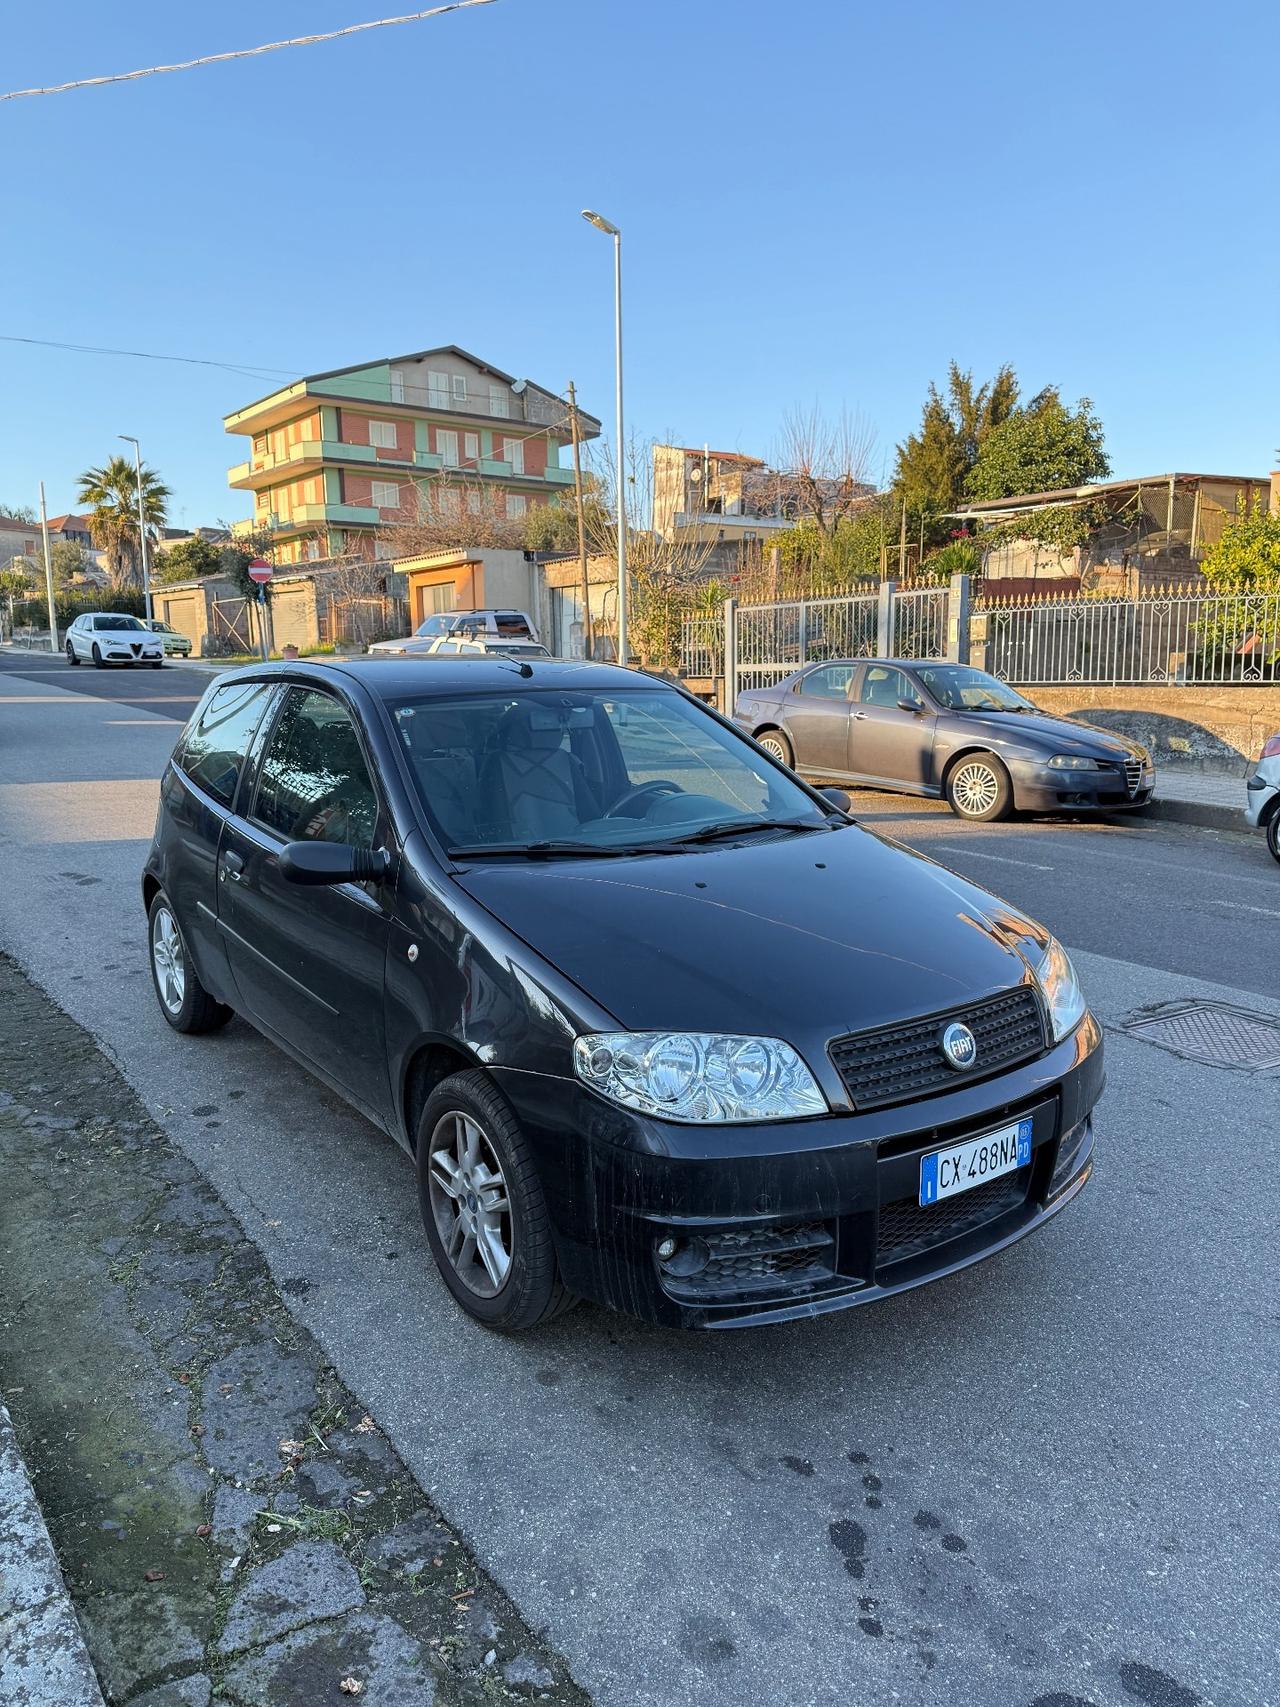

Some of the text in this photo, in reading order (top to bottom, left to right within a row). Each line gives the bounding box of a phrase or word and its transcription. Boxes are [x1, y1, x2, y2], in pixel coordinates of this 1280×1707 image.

[951, 1036, 973, 1055] FIAT
[1018, 1142, 1029, 1160] PD
[940, 1134, 1018, 1189] CX 488NA
[927, 1181, 932, 1199] I
